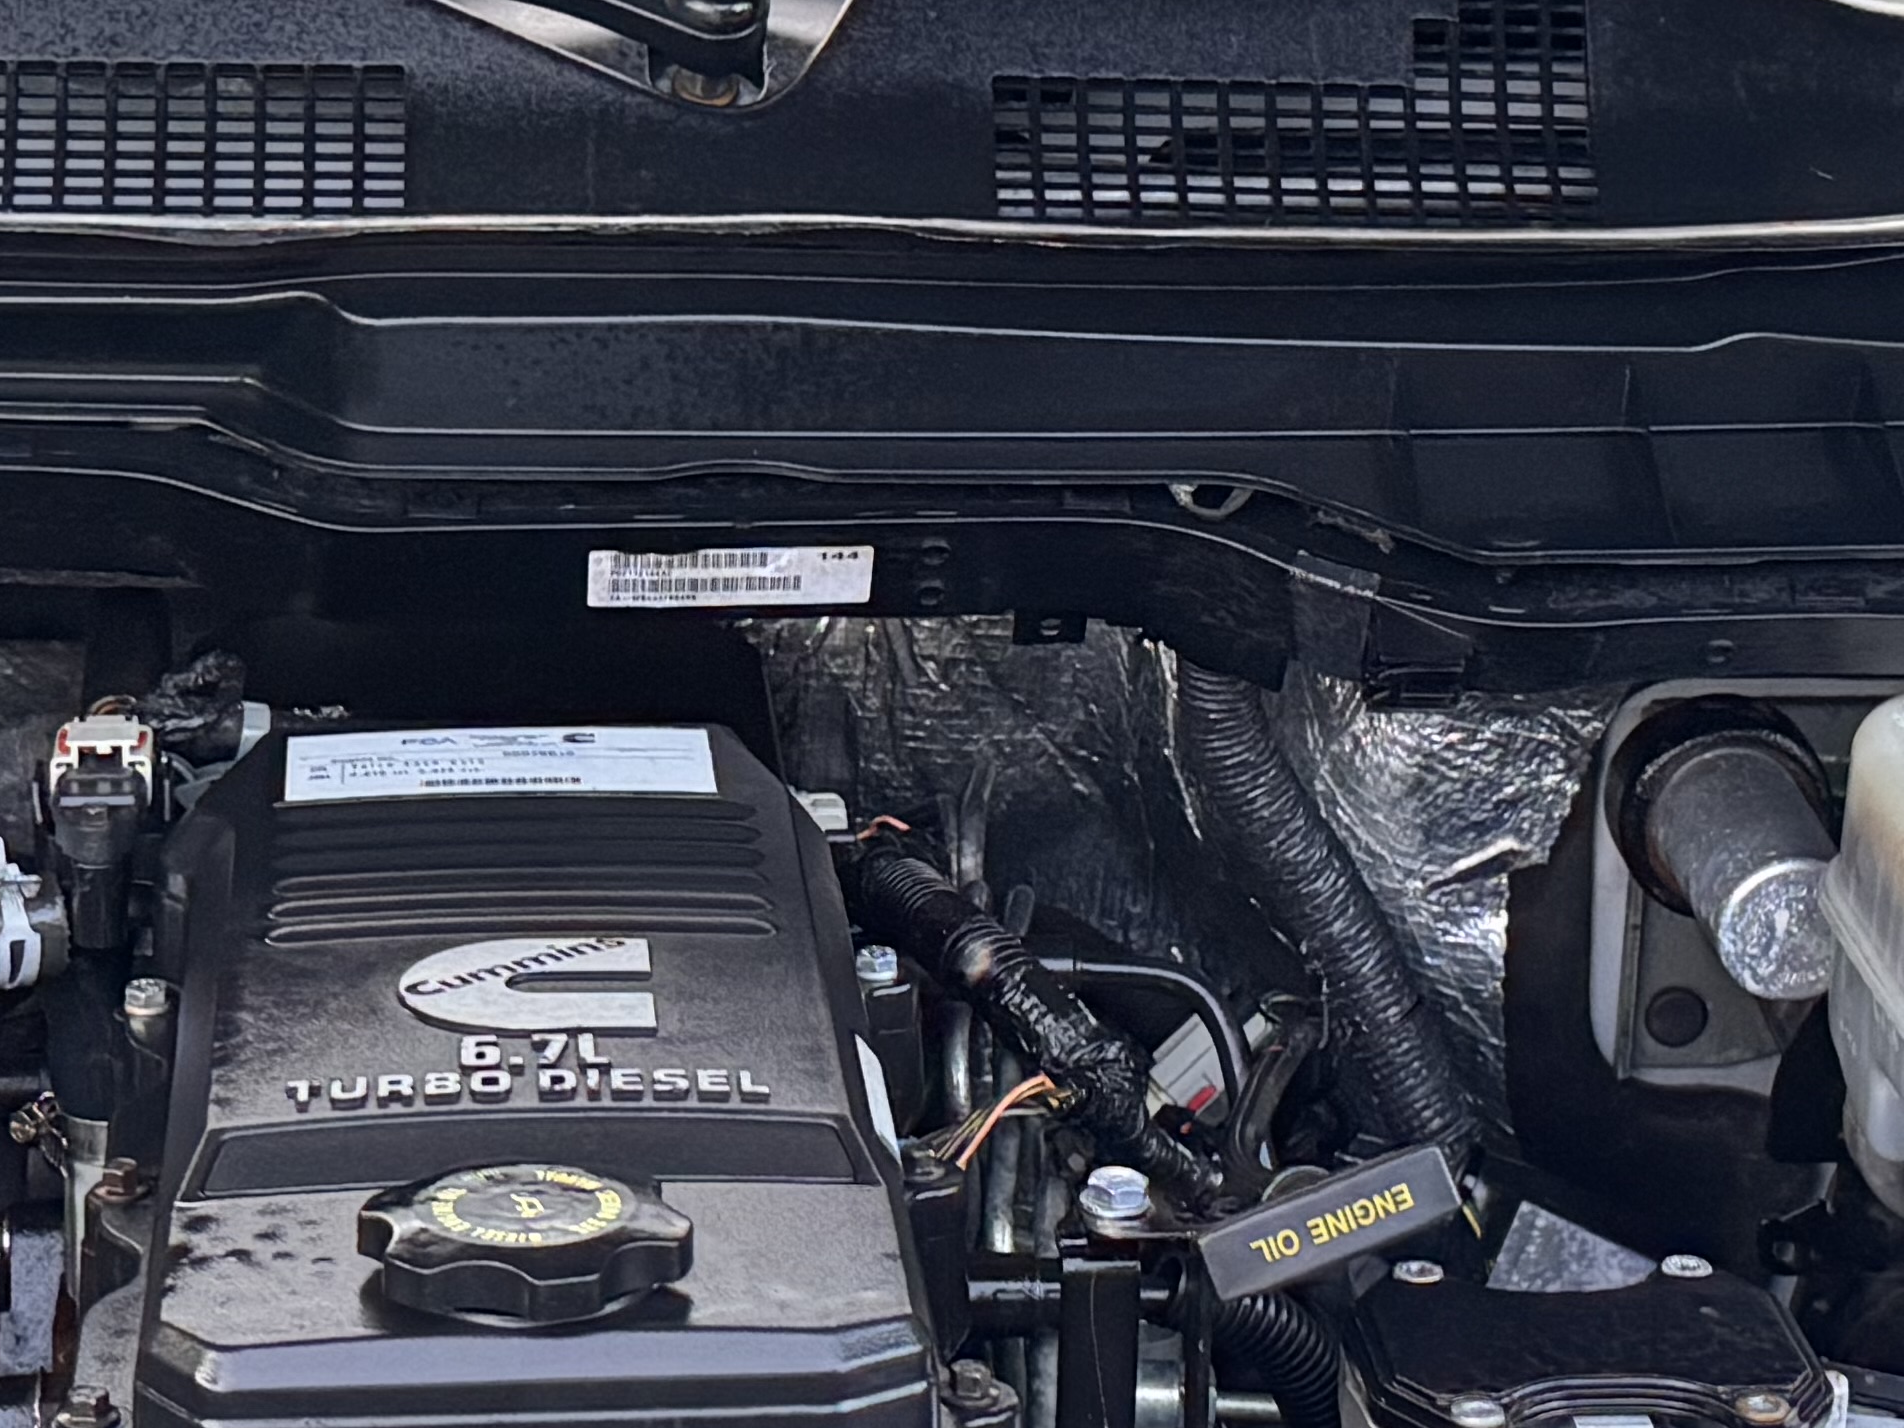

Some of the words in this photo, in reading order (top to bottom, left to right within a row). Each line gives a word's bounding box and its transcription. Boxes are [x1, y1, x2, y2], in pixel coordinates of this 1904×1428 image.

[402, 935, 628, 997] Cummins
[459, 1033, 610, 1069] 6.7L
[286, 1069, 513, 1108] TURBO
[538, 1067, 771, 1102] DIESEL
[1305, 1182, 1416, 1246] ENGINE
[1248, 1228, 1301, 1264] OIL
